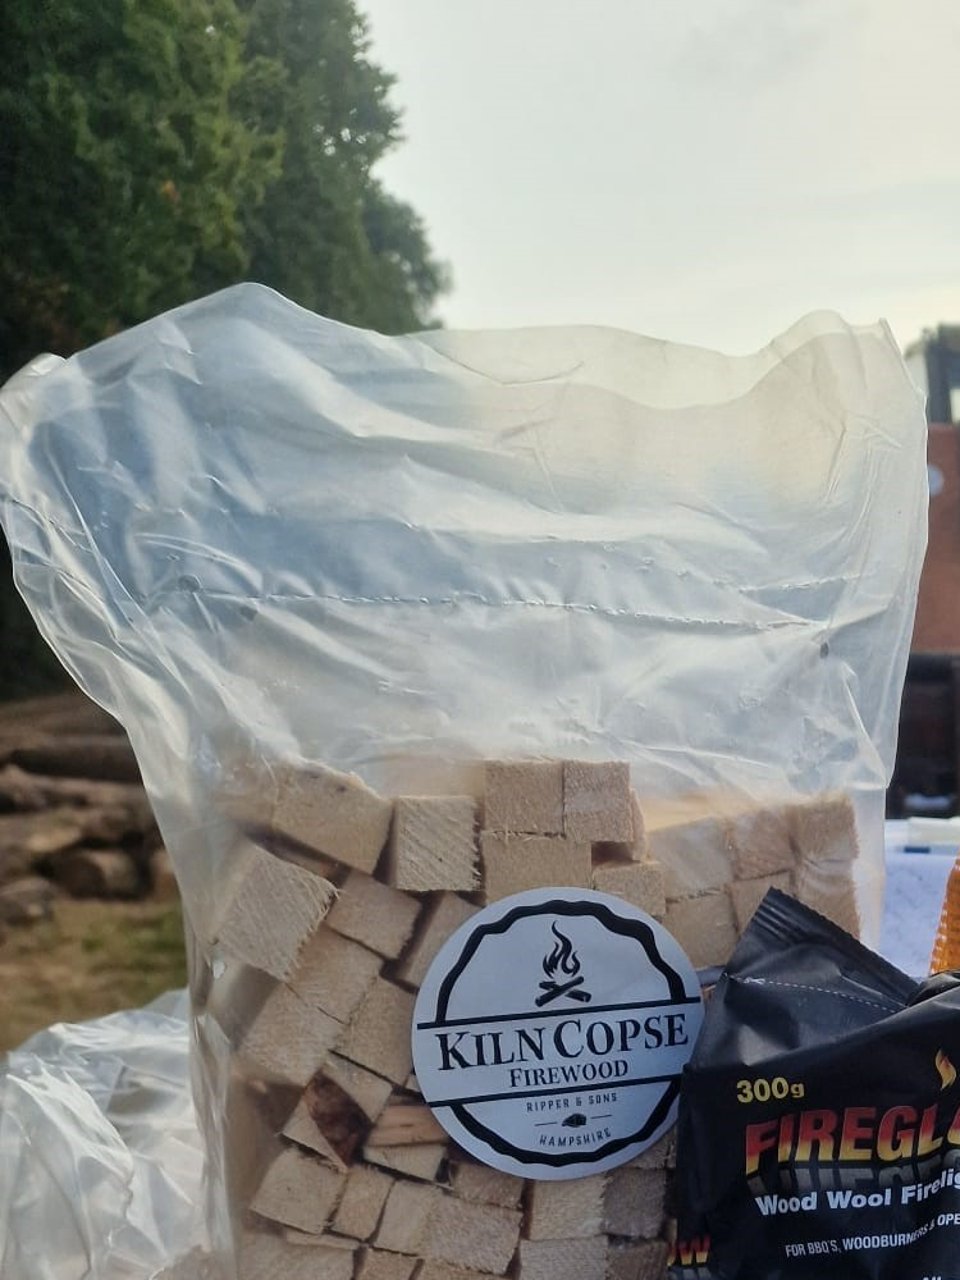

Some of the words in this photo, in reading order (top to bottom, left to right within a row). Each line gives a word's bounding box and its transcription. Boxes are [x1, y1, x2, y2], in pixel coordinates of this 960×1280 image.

[509, 1059, 628, 1088] FIREWOOD
[526, 1098, 569, 1112] RIPPER
[588, 1093, 617, 1105] SONS
[736, 1077, 805, 1103] 300g
[539, 1127, 612, 1147] HAMPSHIRE
[755, 1192, 817, 1216] Wood
[826, 1188, 891, 1210] Wool
[785, 1243, 806, 1258] FOR
[842, 1223, 928, 1251] WOODBURNERS
